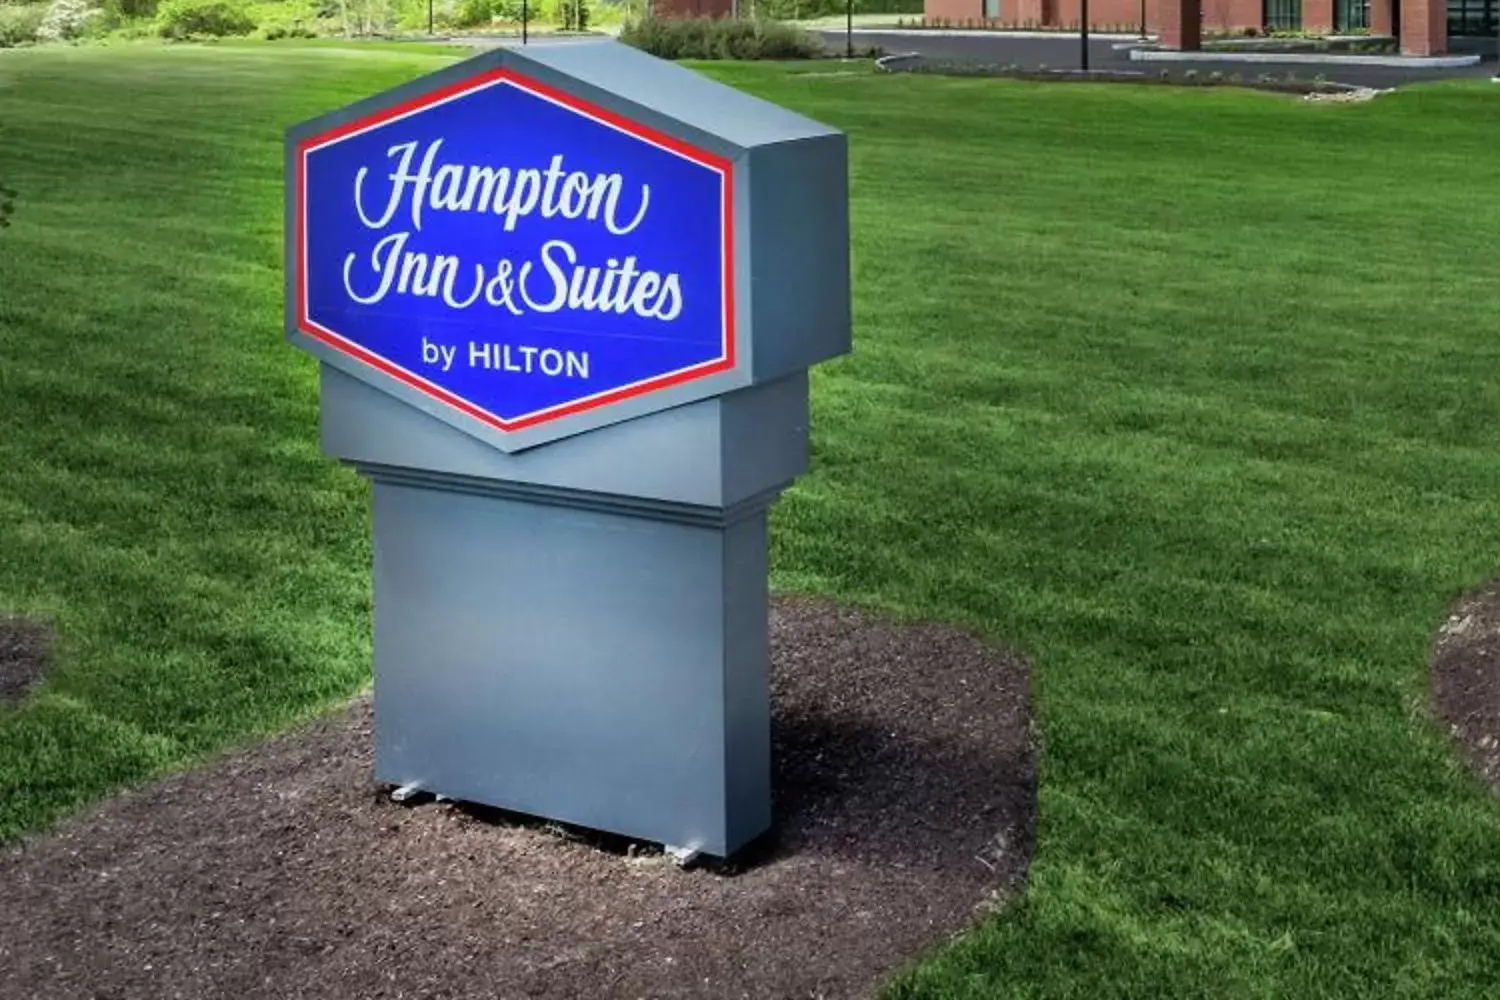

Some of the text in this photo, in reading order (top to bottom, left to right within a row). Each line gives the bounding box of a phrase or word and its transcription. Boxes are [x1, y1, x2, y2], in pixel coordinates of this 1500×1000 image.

[355, 137, 649, 235] Hampton
[343, 232, 683, 321] Inn & Suites
[422, 336, 589, 379] by HILTON
